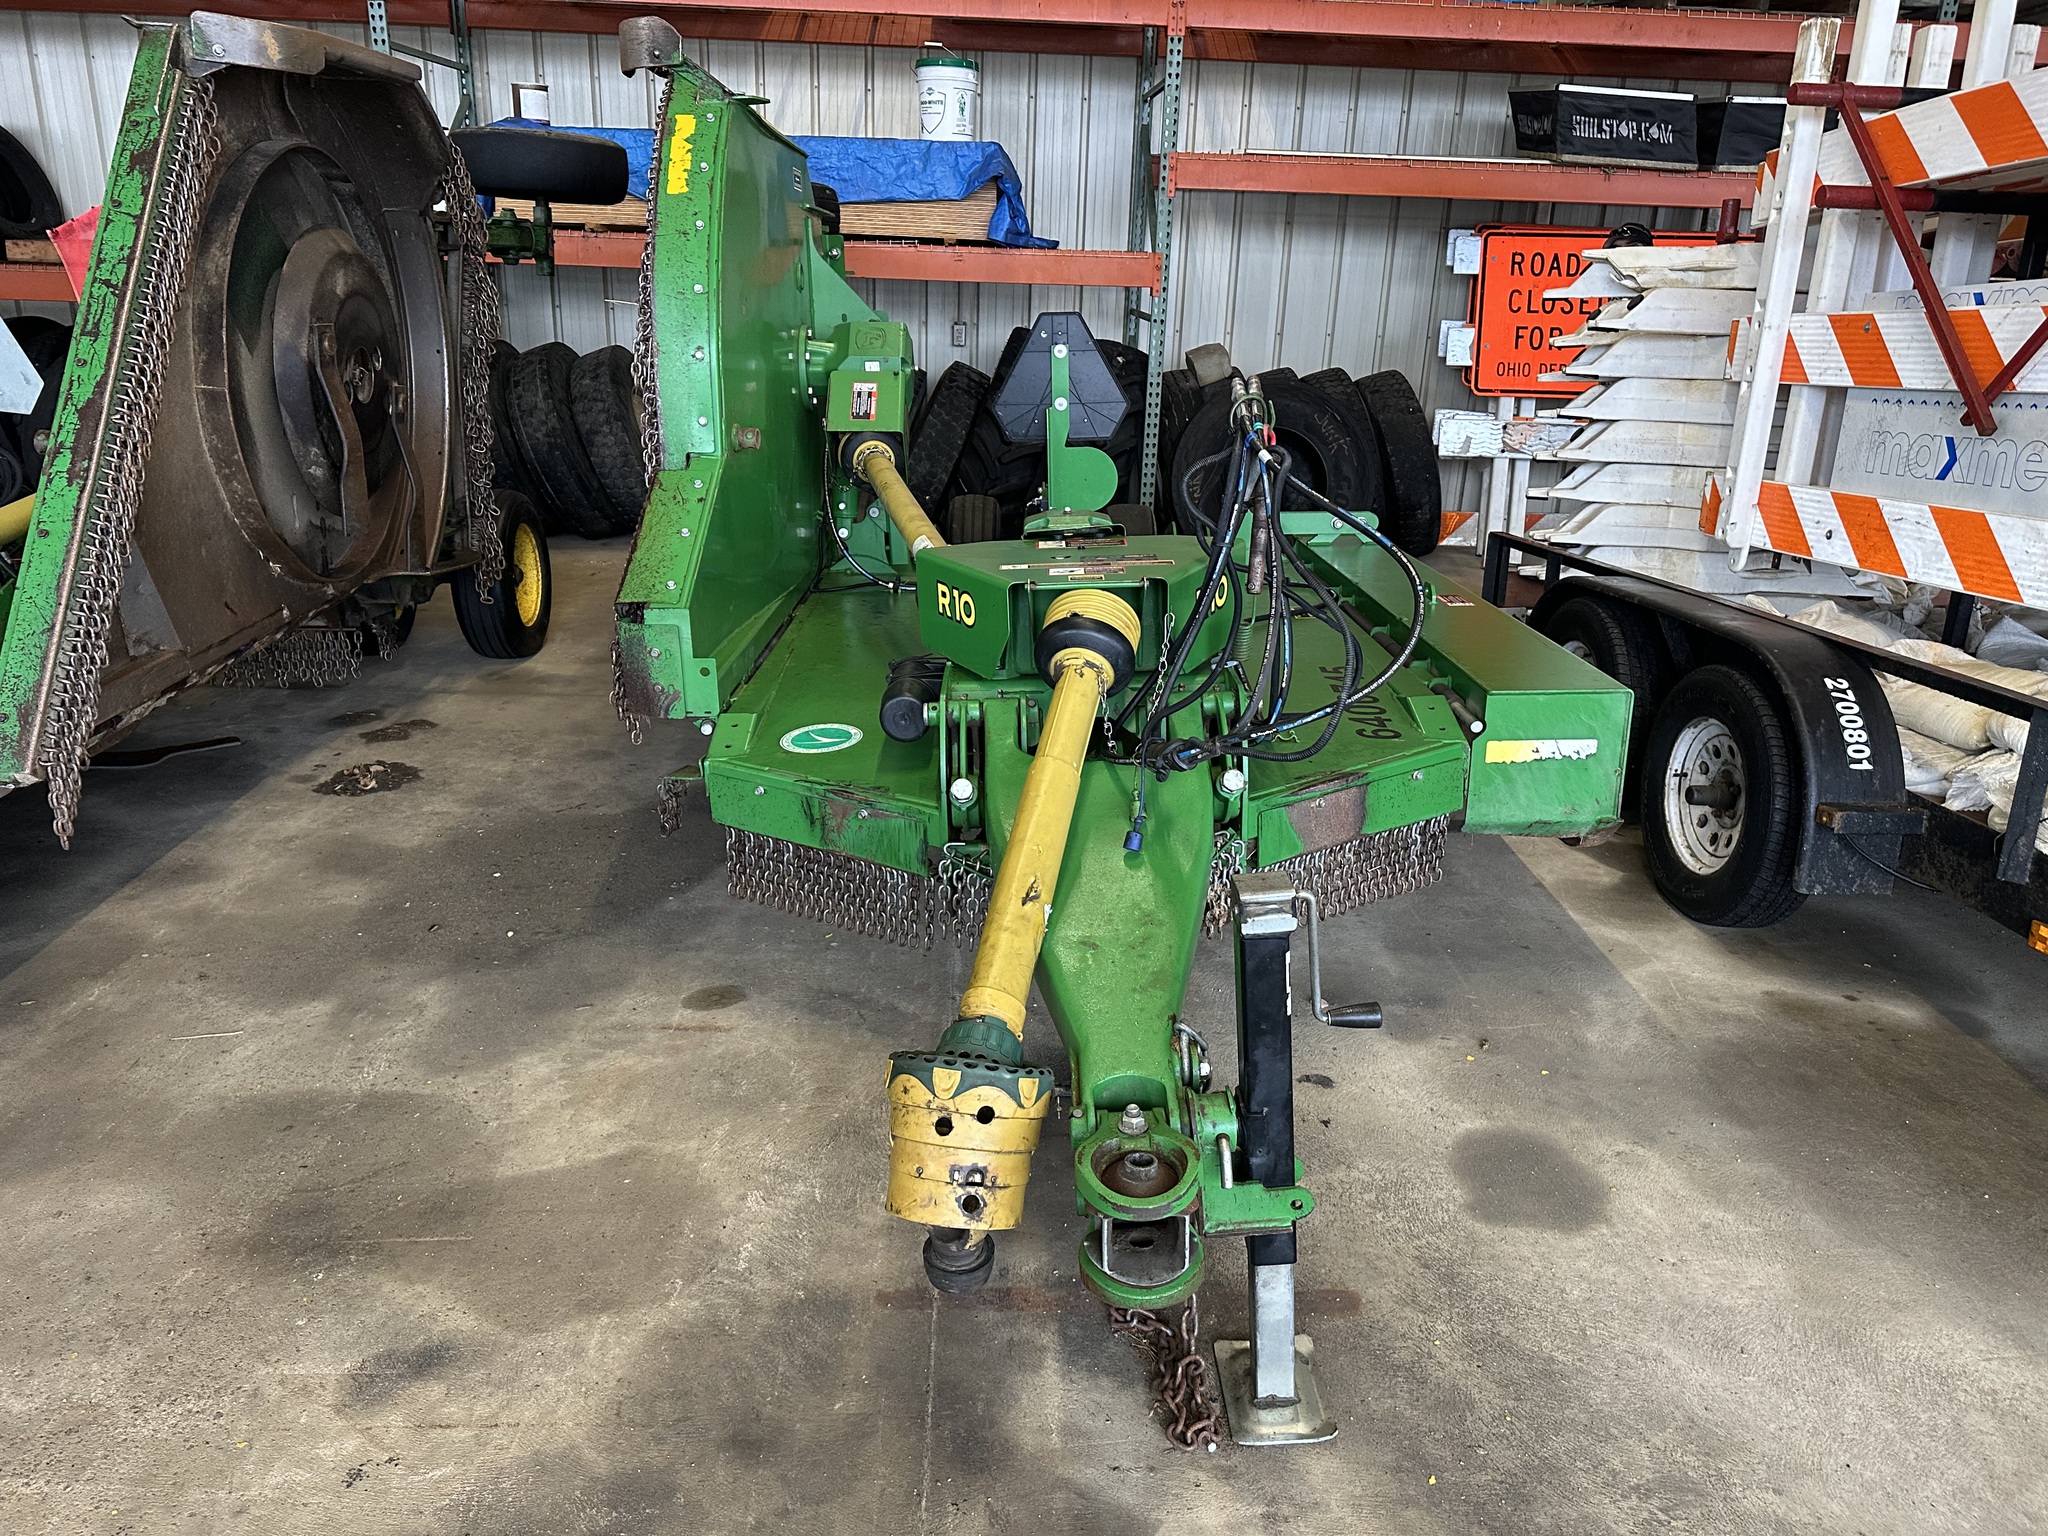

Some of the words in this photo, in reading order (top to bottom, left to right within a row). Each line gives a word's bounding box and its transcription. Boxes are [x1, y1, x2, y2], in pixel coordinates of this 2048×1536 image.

[1510, 252, 1581, 277] ROAD
[1496, 361, 1531, 378] OHIO
[936, 579, 977, 629] R10
[1823, 677, 1875, 770] 2700801
